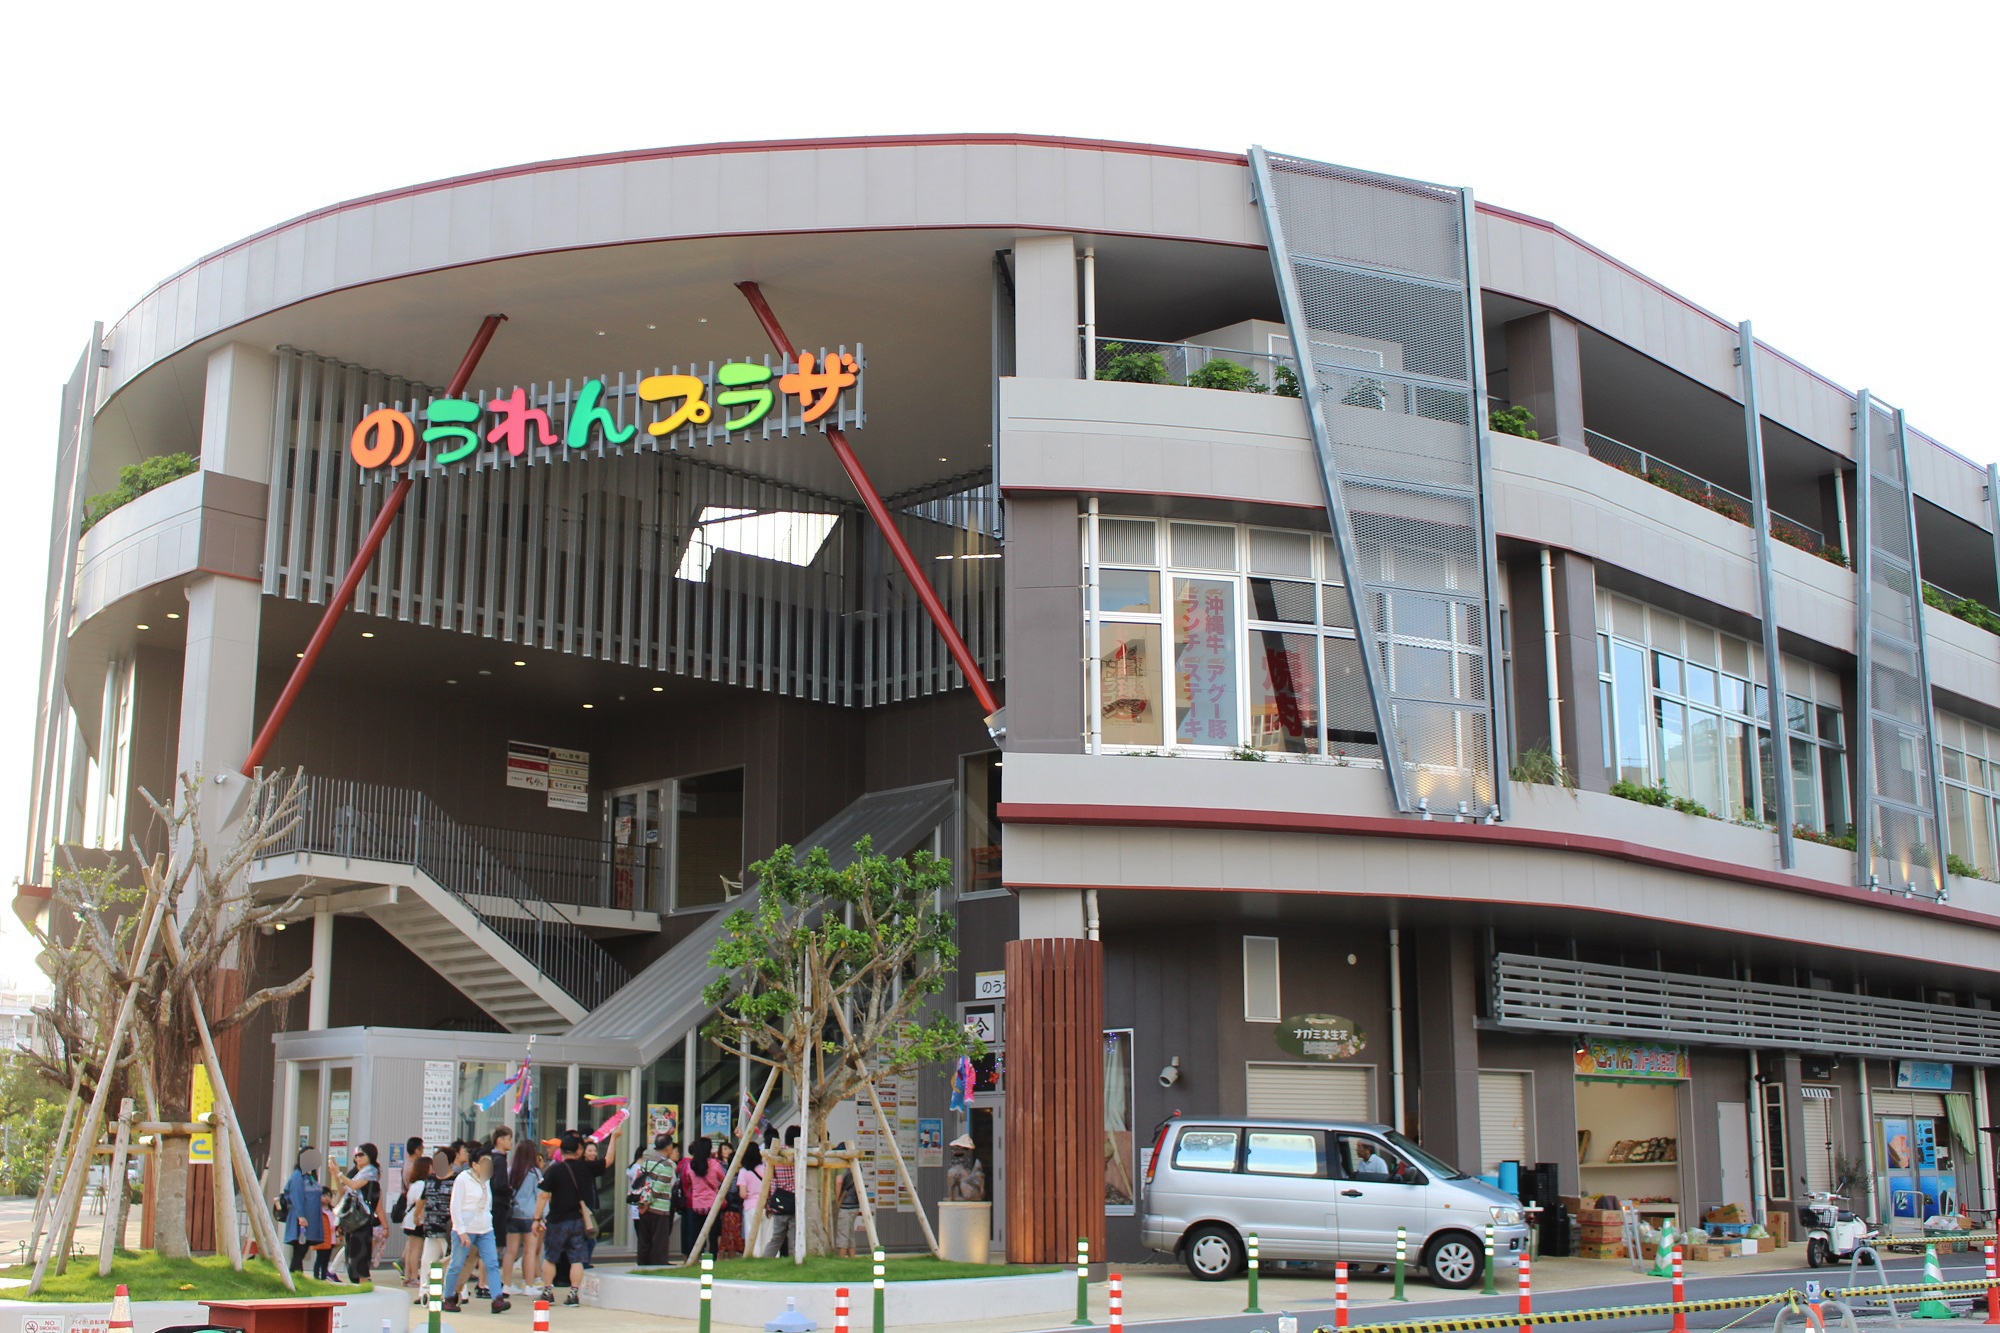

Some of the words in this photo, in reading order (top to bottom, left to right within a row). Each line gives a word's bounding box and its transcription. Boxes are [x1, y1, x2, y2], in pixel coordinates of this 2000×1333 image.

[350, 352, 859, 469] のうれんプラザ
[1182, 594, 1201, 653] ランチ
[1205, 596, 1225, 654] 沖縄牛
[1183, 663, 1203, 738] ステーキ
[1207, 664, 1228, 739] アグー豚
[1293, 1028, 1348, 1041] ナガミネ生花
[705, 1111, 728, 1127] 移転
